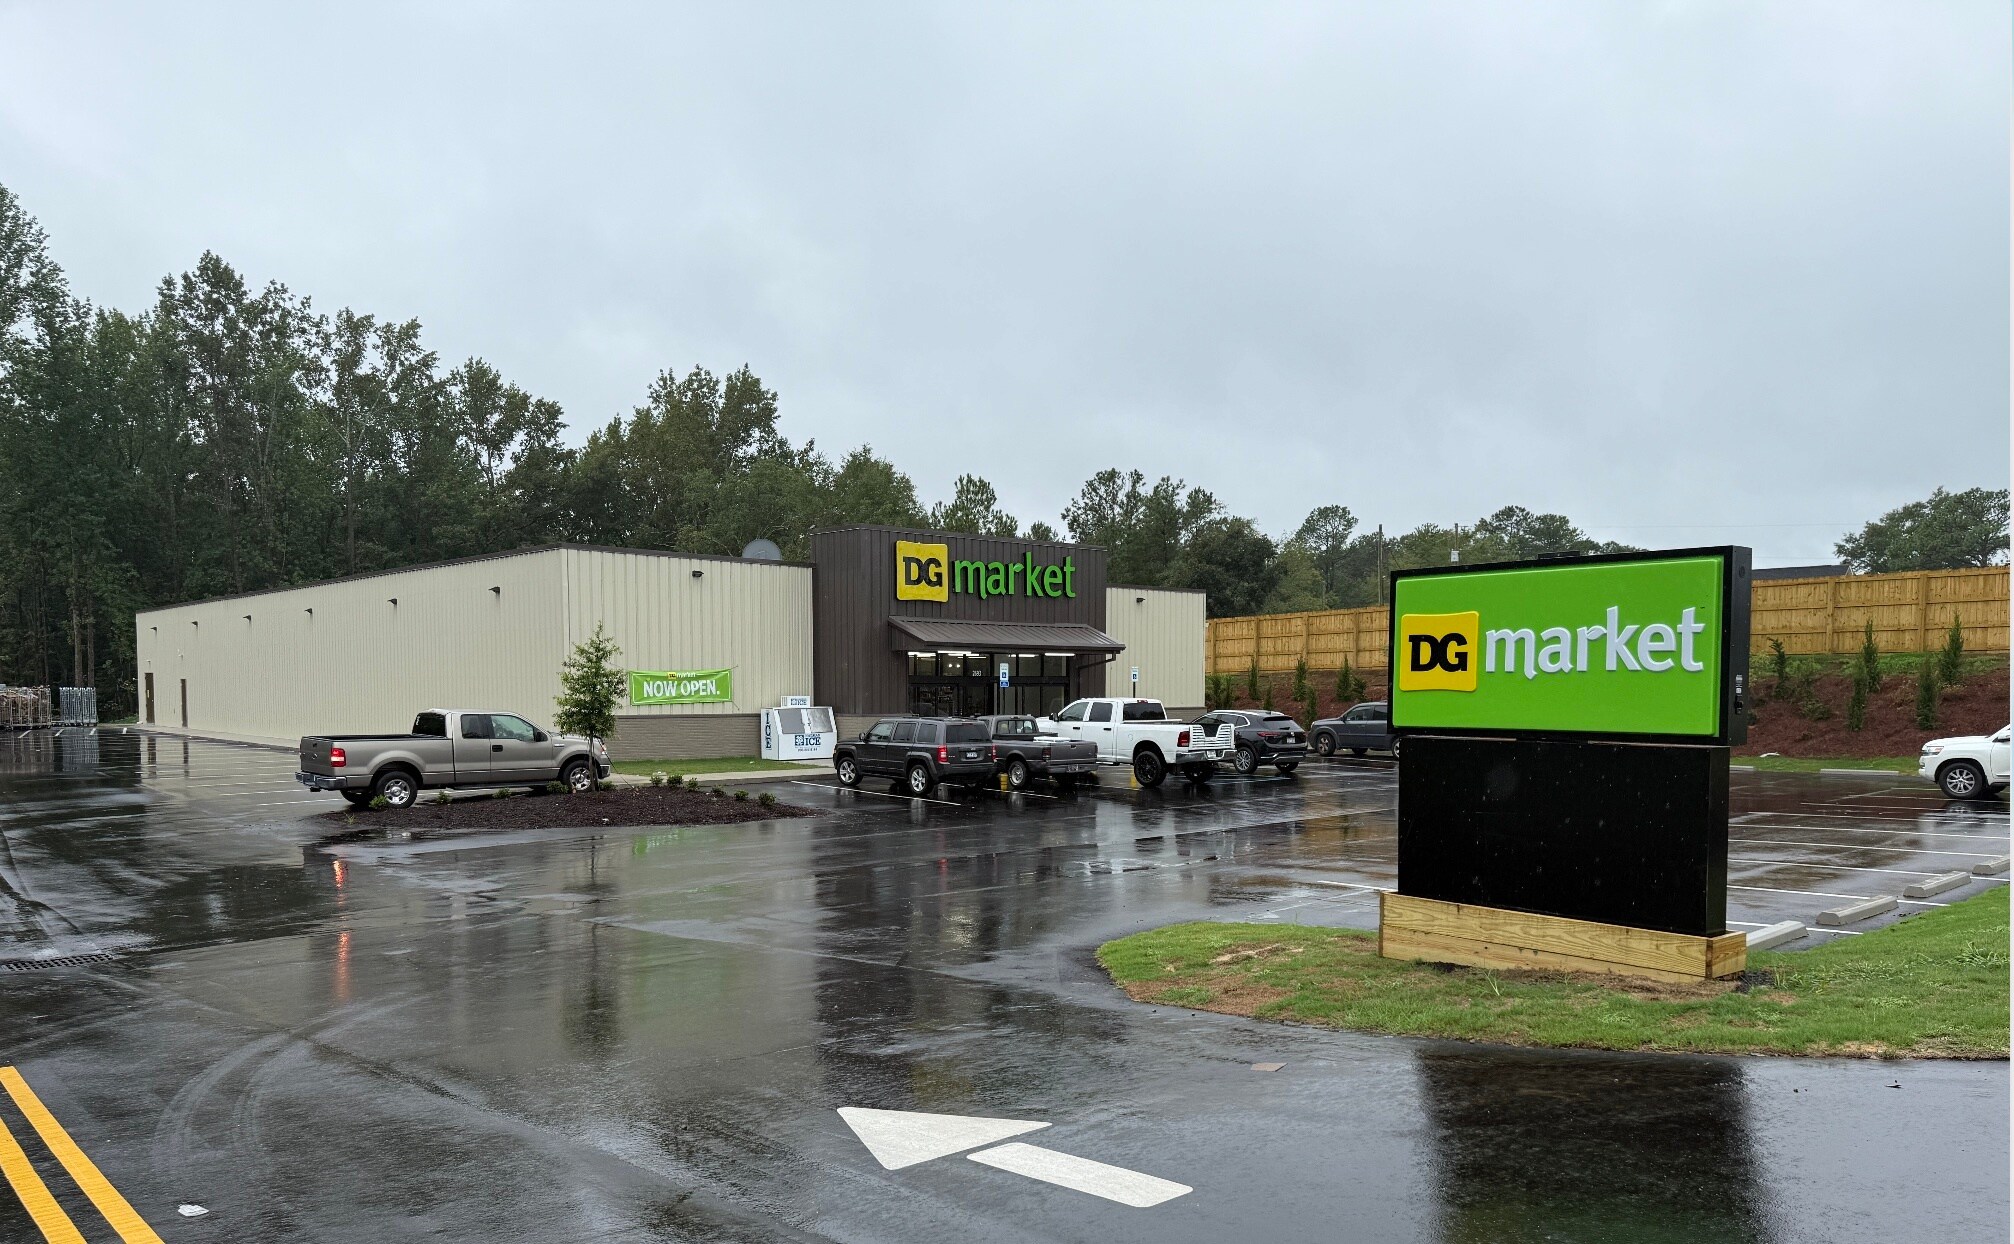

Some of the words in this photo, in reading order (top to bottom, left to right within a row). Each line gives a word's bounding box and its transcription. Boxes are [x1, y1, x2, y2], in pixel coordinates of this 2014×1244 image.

[903, 556, 943, 588] DG
[954, 551, 1076, 600] market
[1408, 632, 1469, 673] DG
[1486, 605, 1706, 680] market
[643, 680, 677, 698] NOW
[680, 679, 720, 697] OPEN.
[805, 737, 821, 746] ICE
